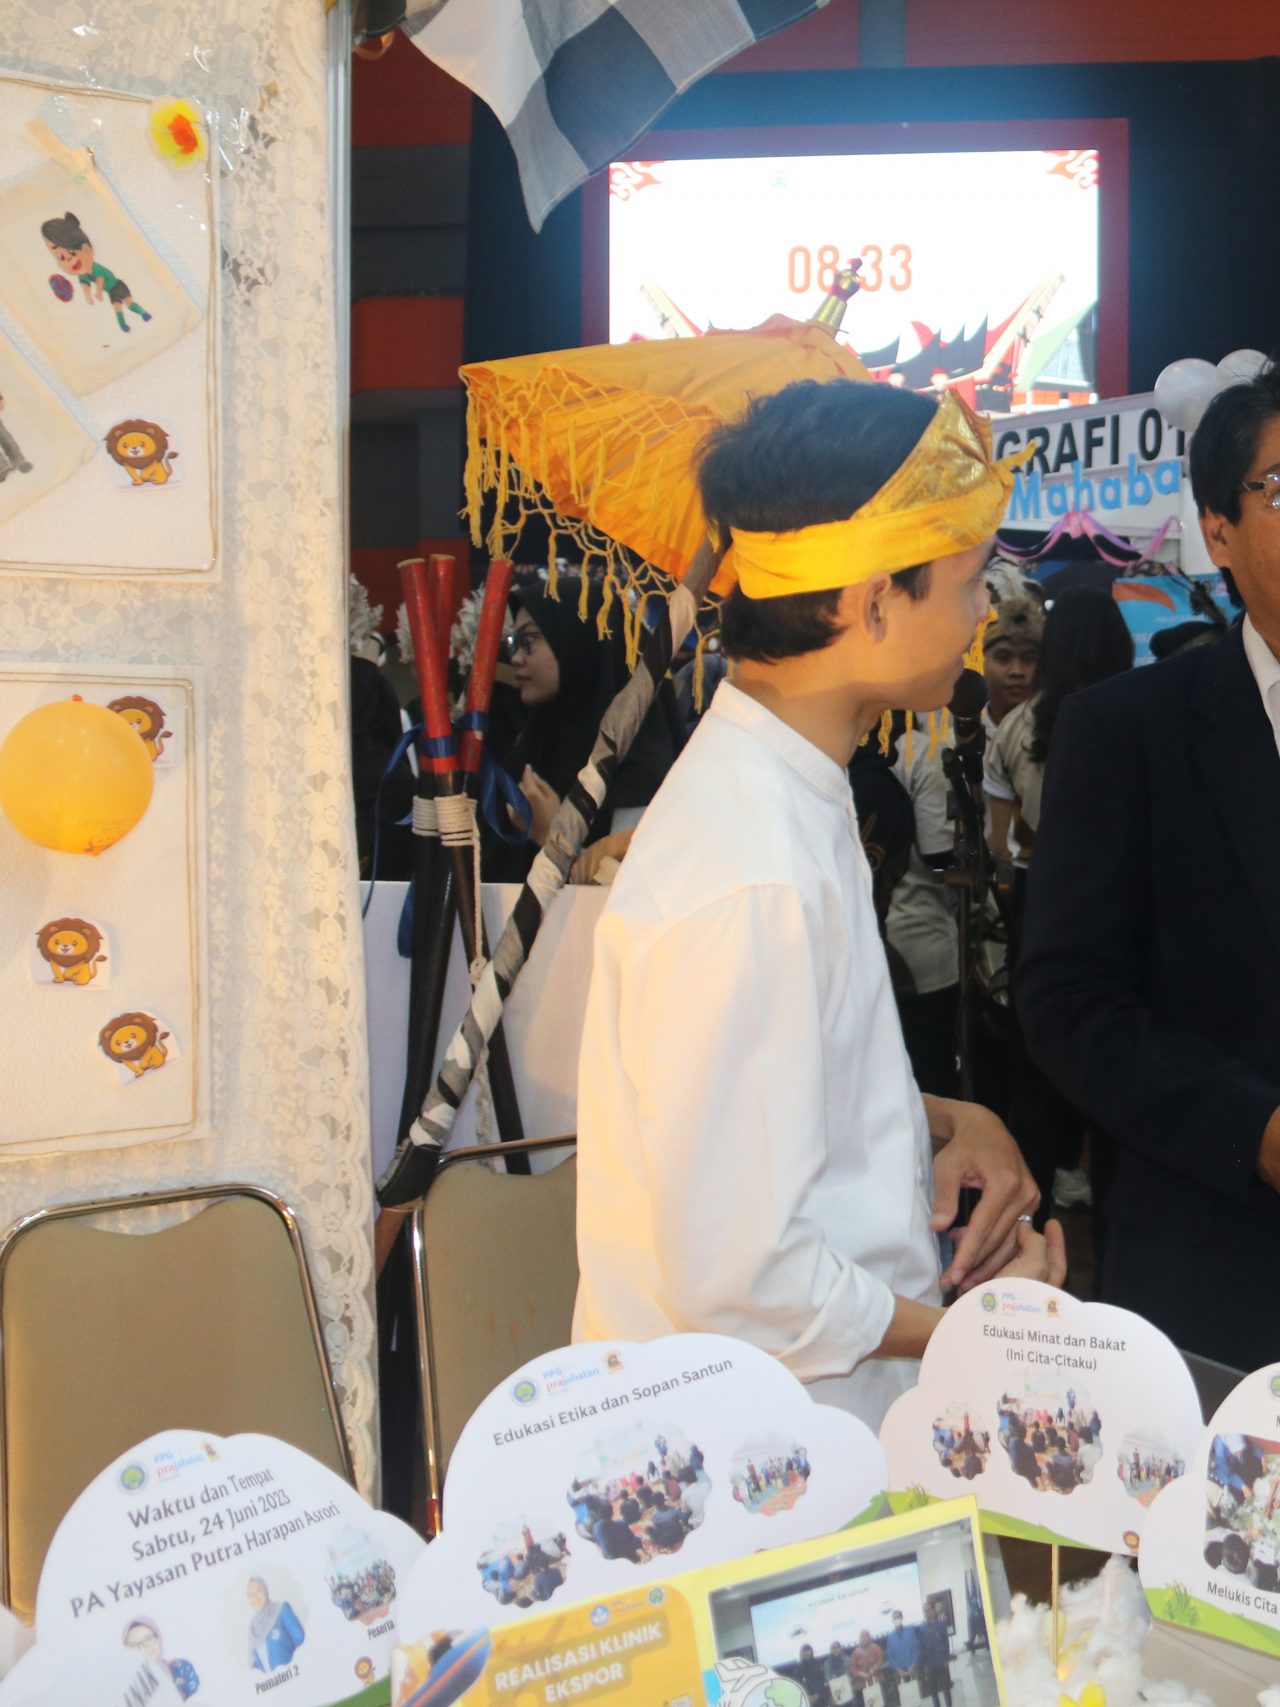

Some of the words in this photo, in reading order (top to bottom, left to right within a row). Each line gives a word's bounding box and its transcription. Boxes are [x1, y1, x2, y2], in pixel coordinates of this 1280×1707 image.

[788, 244, 913, 293] 0833
[983, 1324, 1024, 1341] Edukasi
[1027, 1330, 1061, 1345] Minat
[1063, 1334, 1086, 1348] dan
[1089, 1336, 1126, 1352] Bakat
[1006, 1347, 1024, 1362] (Ini
[1027, 1350, 1098, 1371] Cita-Citaku)
[493, 1415, 556, 1446] Edukasi
[558, 1402, 599, 1426] Etika
[600, 1393, 630, 1412] dan
[632, 1378, 680, 1402] Sopan
[682, 1358, 734, 1385] Santun
[127, 1494, 196, 1528] Waktu
[200, 1483, 230, 1505] dan
[227, 1467, 275, 1493] Tempat
[131, 1528, 196, 1561] Sabtu,
[200, 1513, 224, 1536] 24
[225, 1500, 259, 1529] Juni
[258, 1488, 291, 1513] 2023
[70, 1591, 105, 1618] PA
[106, 1562, 188, 1602] Yayasan
[190, 1541, 243, 1572] Putra
[244, 1514, 305, 1550] Harapan
[304, 1500, 341, 1527] Asrori
[1206, 1580, 1251, 1607] Melukis
[1253, 1596, 1278, 1615] Cita
[367, 1619, 395, 1640] Peserta
[494, 1642, 596, 1691] REALISASI
[599, 1621, 663, 1657] KLINIK
[255, 1668, 293, 1695] Pemateri
[293, 1664, 300, 1677] 2
[544, 1662, 625, 1703] EKSPOR
